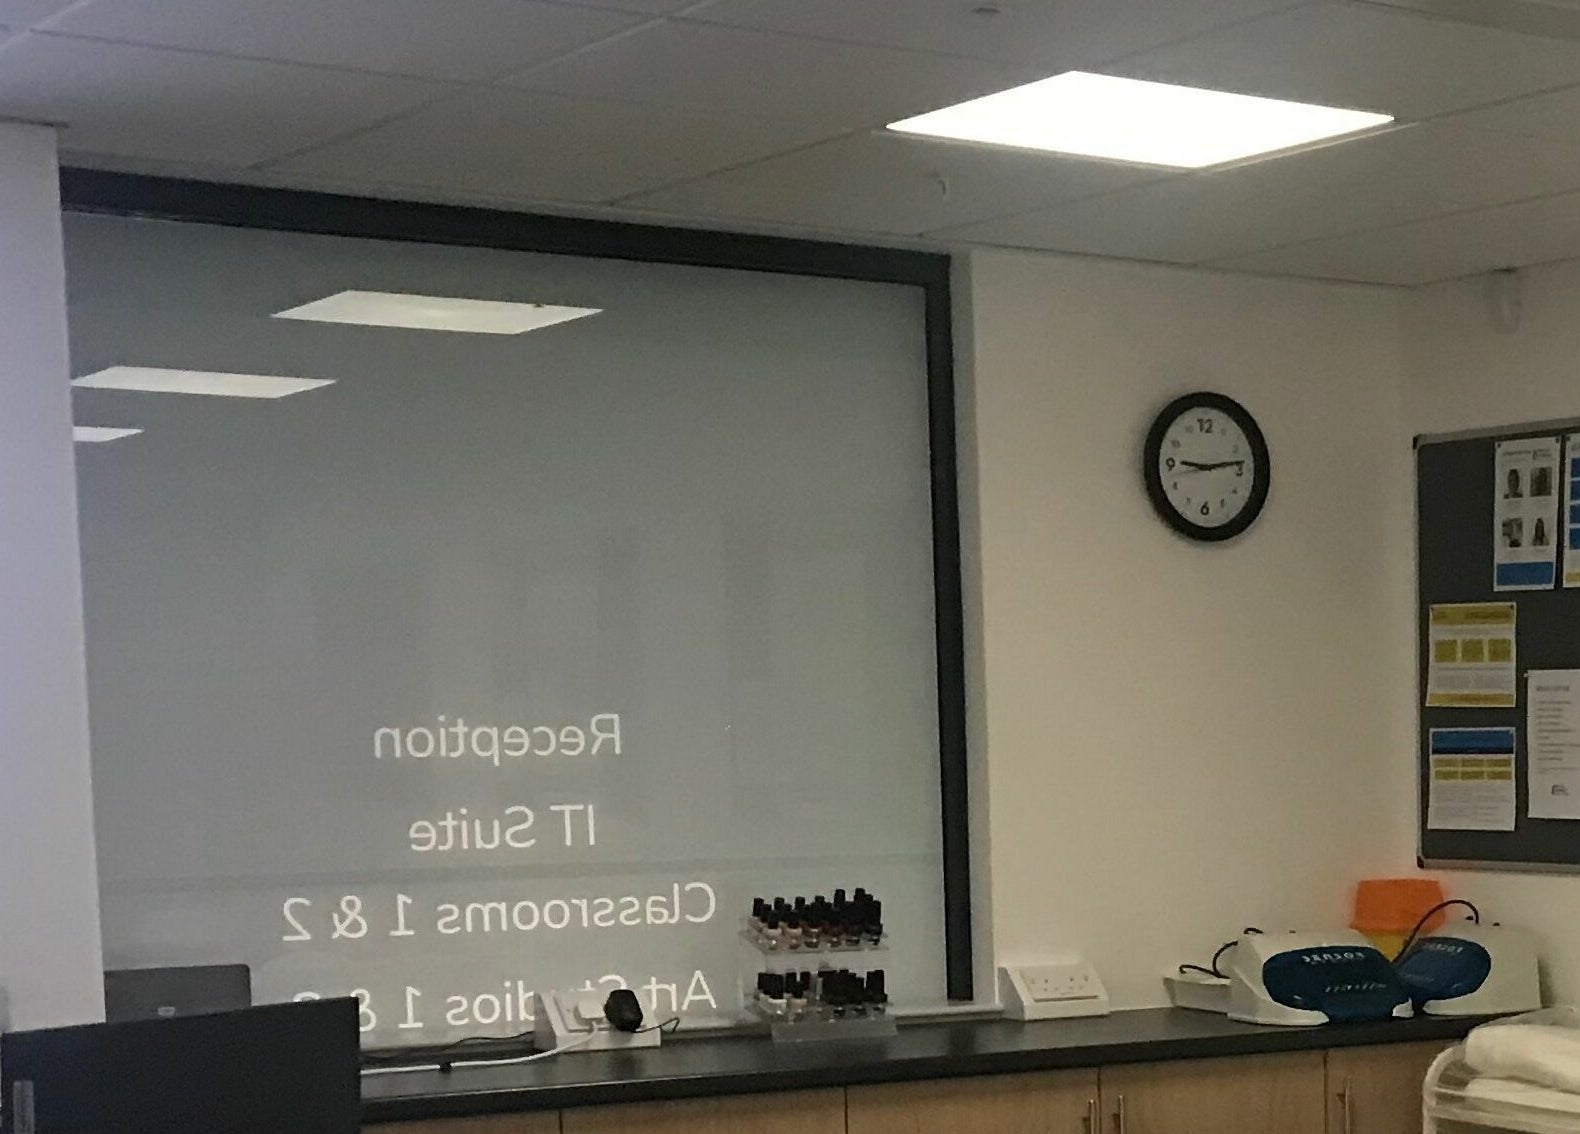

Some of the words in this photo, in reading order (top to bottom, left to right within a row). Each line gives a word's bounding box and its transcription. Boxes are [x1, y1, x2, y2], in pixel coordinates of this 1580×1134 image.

[1197, 418, 1214, 434] 12
[1166, 457, 1176, 471] 9
[1200, 501, 1210, 516] 6
